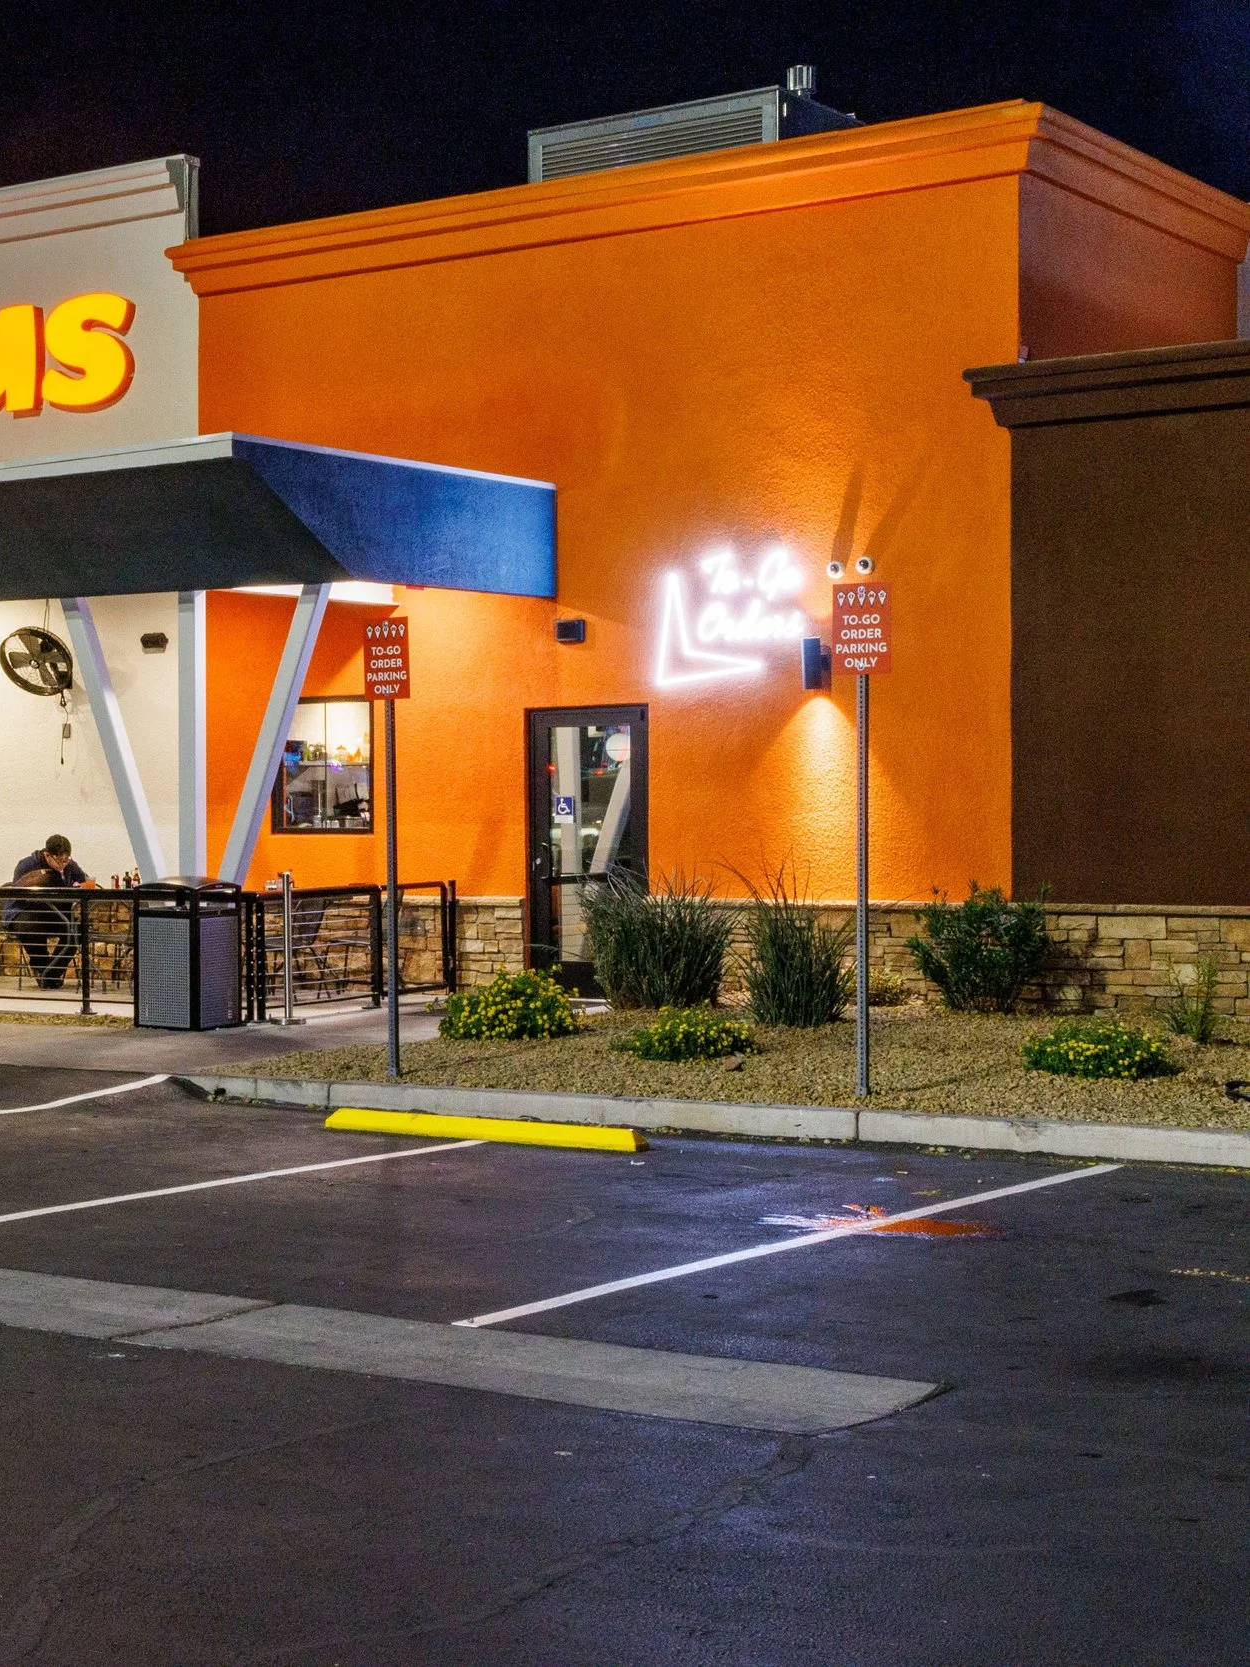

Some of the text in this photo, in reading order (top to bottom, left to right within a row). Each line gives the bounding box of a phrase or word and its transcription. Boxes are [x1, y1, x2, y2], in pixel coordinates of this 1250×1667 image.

[698, 598, 804, 641] Orders
[840, 628, 882, 640] ORDER
[371, 646, 401, 656] TO-GO
[835, 642, 887, 654] PARKING
[370, 659, 402, 668] ORDER
[844, 656, 878, 668] ONLY
[367, 671, 407, 682] PARKING
[374, 684, 400, 694] ONLY
